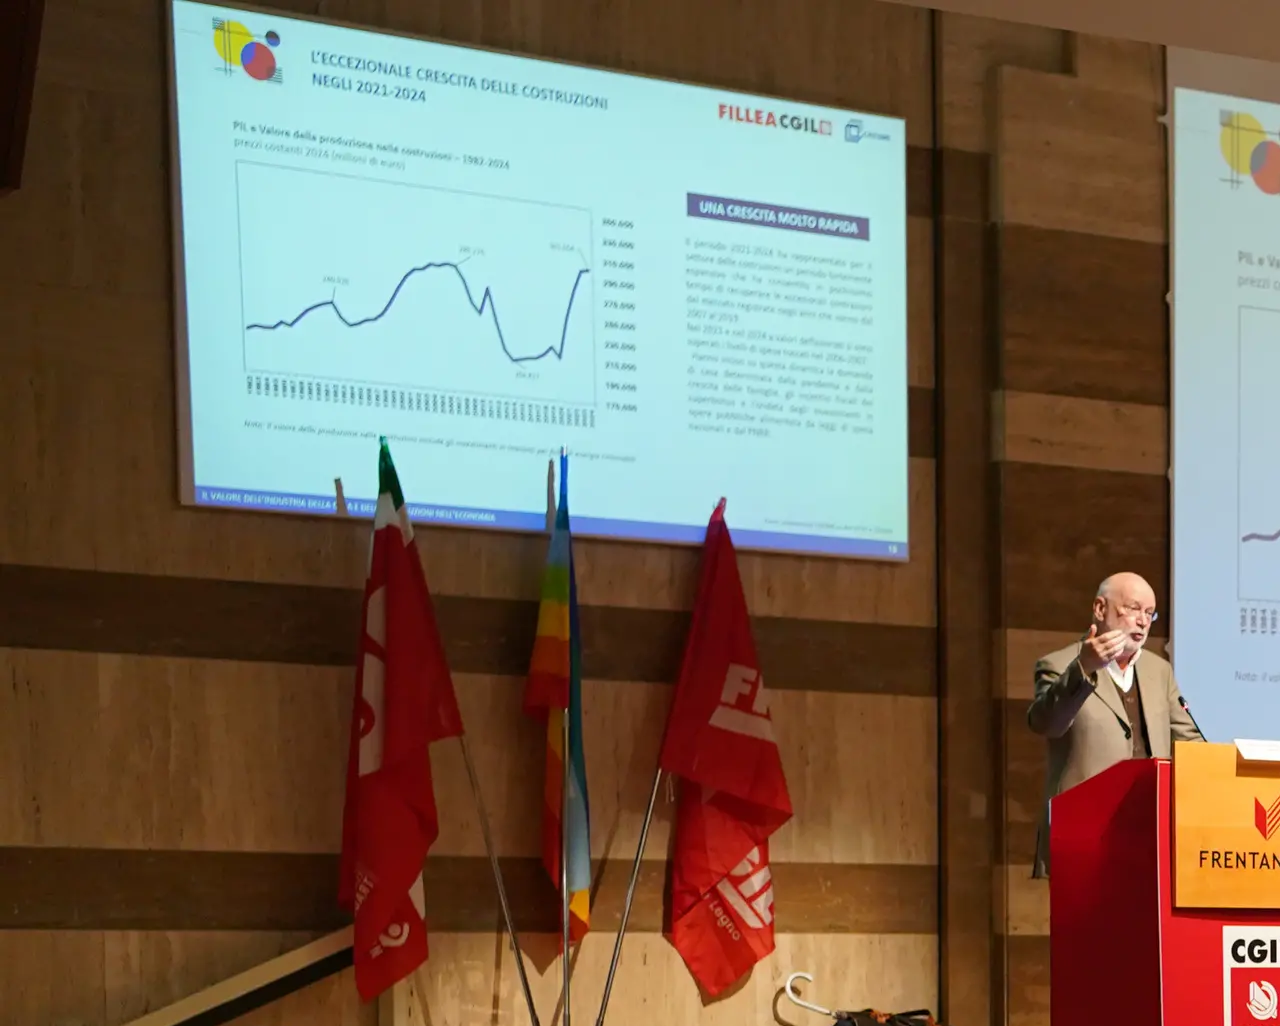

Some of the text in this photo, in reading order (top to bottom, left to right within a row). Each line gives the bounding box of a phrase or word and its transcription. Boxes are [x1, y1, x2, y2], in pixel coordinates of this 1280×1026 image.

[311, 51, 607, 110] L'ECCEZIONALE CRESCITA DELLE COSTRUZIONI
[312, 73, 426, 102] NEGLI 2021-2024
[700, 201, 858, 234] UNA CRESCITA MOLTO RAPIDA
[1238, 252, 1254, 265] PIL
